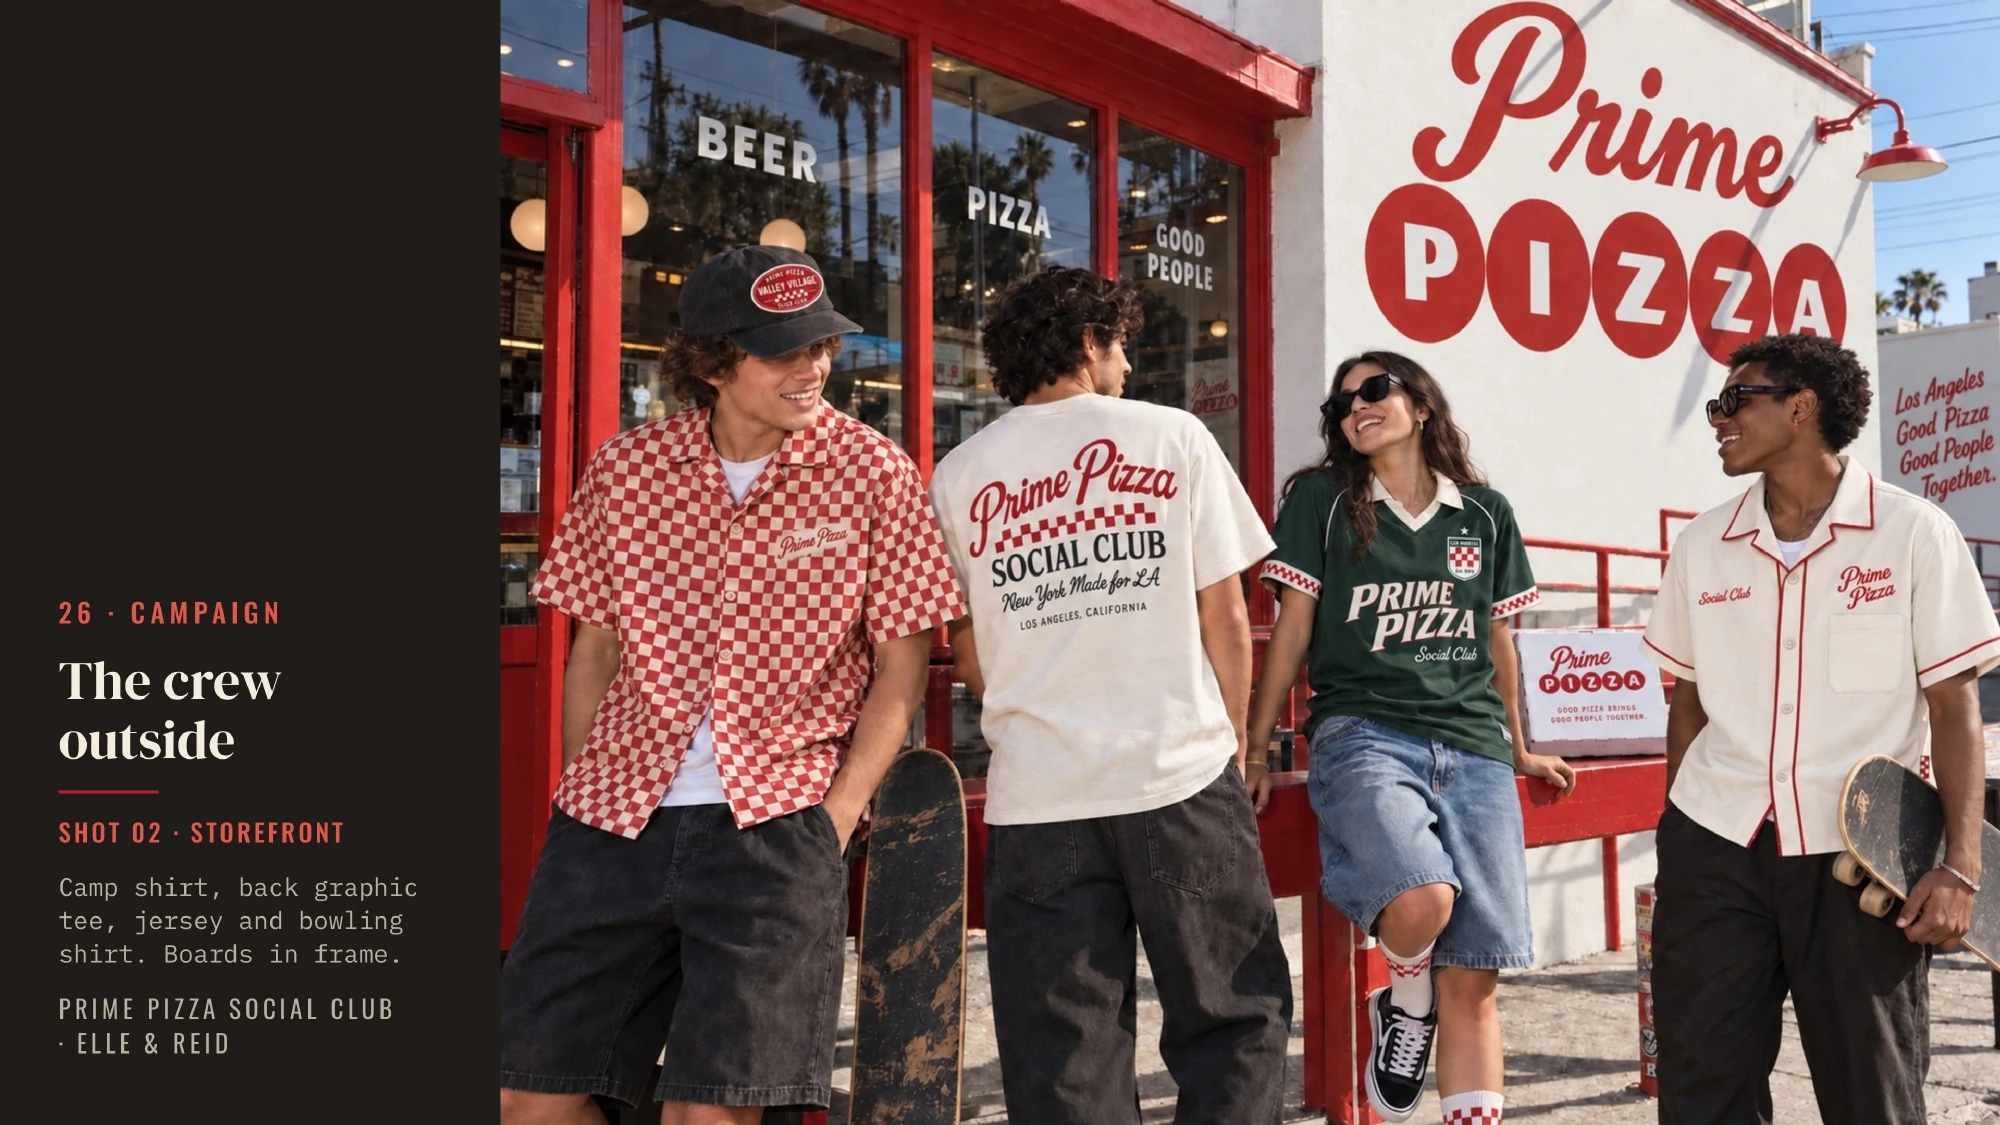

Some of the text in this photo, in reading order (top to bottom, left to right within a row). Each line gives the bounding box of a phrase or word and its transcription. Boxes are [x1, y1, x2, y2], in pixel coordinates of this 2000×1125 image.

[1412, 1, 1794, 208] Prime
[698, 115, 818, 183] BEER
[968, 185, 1052, 239] PIZZA
[1156, 223, 1205, 258] GOOD
[758, 275, 818, 296] VALLEY VILLAGE
[1147, 253, 1213, 291] PEOPLE
[1403, 222, 1831, 335] PIZZA
[1895, 366, 1984, 416] Los Angeles
[1896, 406, 1990, 446] Good Pizza
[1900, 428, 1995, 475] Good People
[969, 438, 1178, 558] Prime Pizza
[1921, 464, 1997, 503] Together.
[777, 527, 848, 559] Prime Pizza
[991, 530, 1166, 588] SOCIAL CLUB
[1002, 567, 1160, 613] New York Made for LA
[1698, 585, 1752, 606] Social Club
[1837, 565, 1892, 592] Prime
[1846, 583, 1896, 610] Pizza
[1020, 602, 1147, 631] LOS ANGELES, CALIFORNIA
[1344, 580, 1455, 623] PRIME
[1369, 607, 1476, 653] PIZZA
[1414, 646, 1478, 663] Social Club
[1550, 645, 1612, 675] Prime
[1544, 673, 1641, 691] PIZZA
[1550, 716, 1571, 724] GOOD
[1606, 713, 1648, 721] TOGETHER.
[1557, 704, 1636, 714] GOOD PIZZA BRINGS
